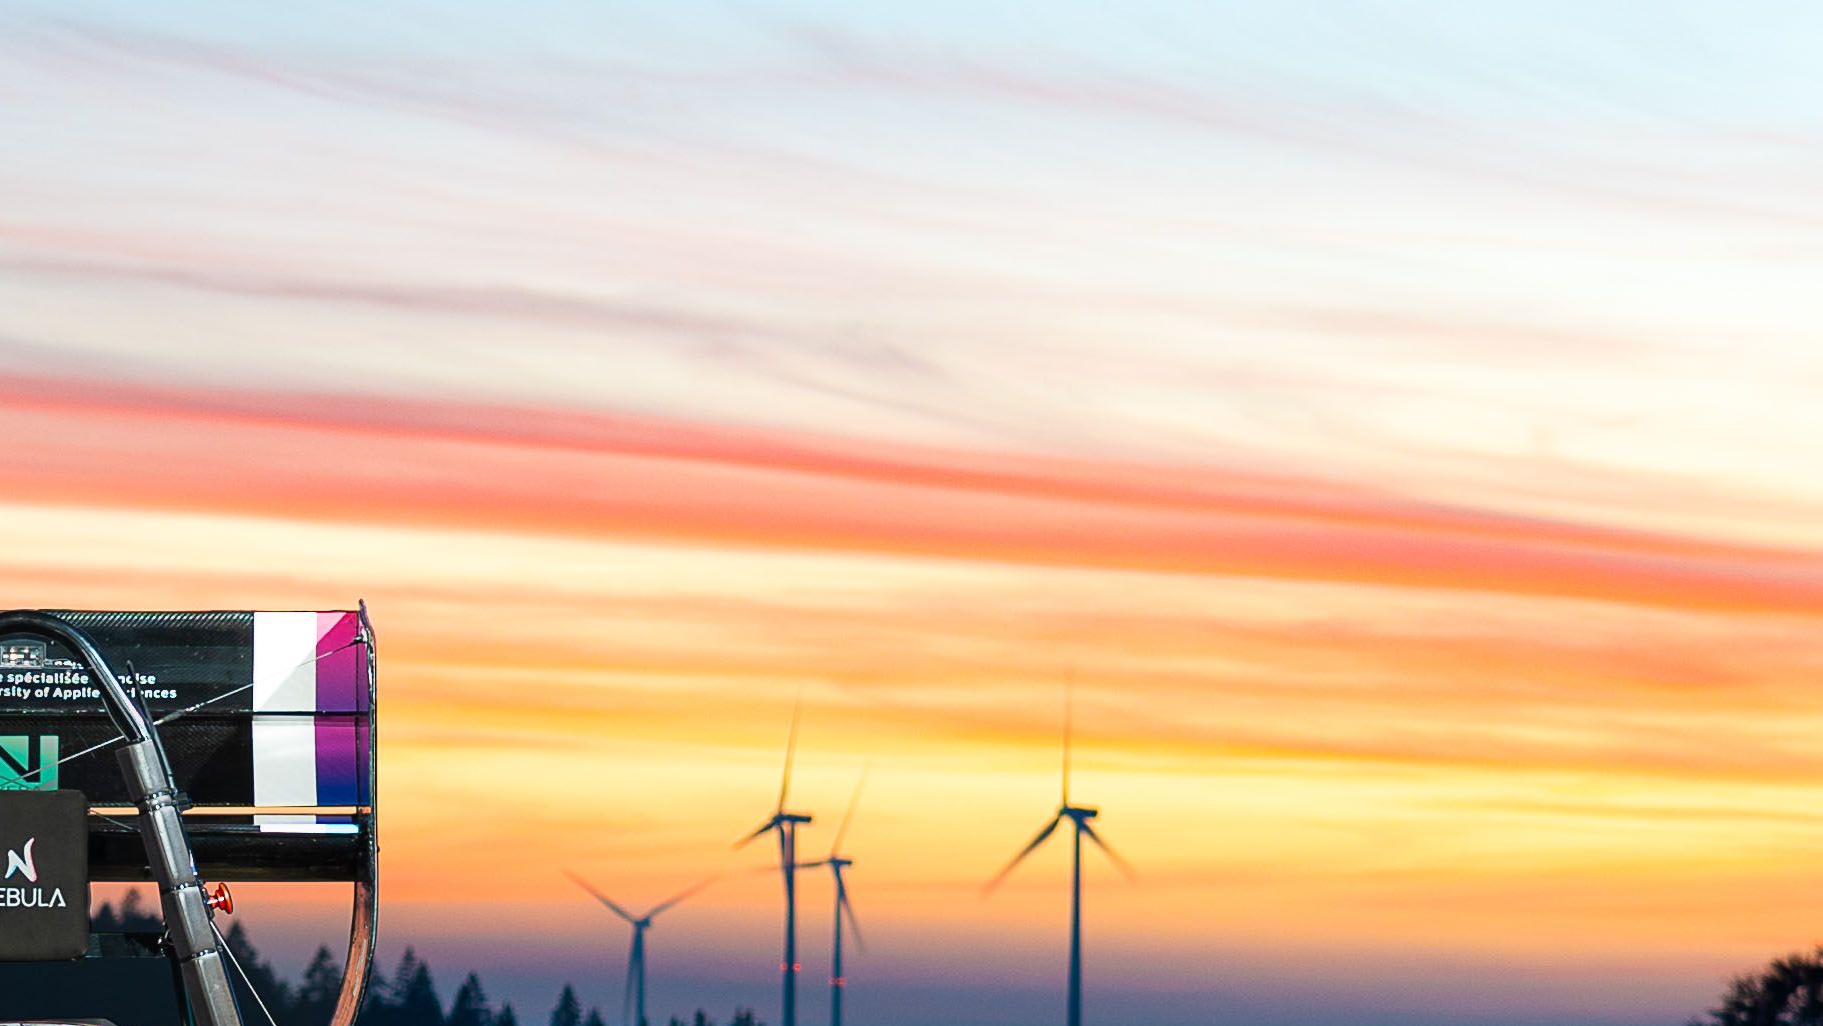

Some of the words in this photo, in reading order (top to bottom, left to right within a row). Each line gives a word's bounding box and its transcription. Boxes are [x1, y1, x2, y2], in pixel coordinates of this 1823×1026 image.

[7, 671, 89, 688] spécialisée
[34, 687, 50, 698] of
[53, 687, 100, 699] Applie
